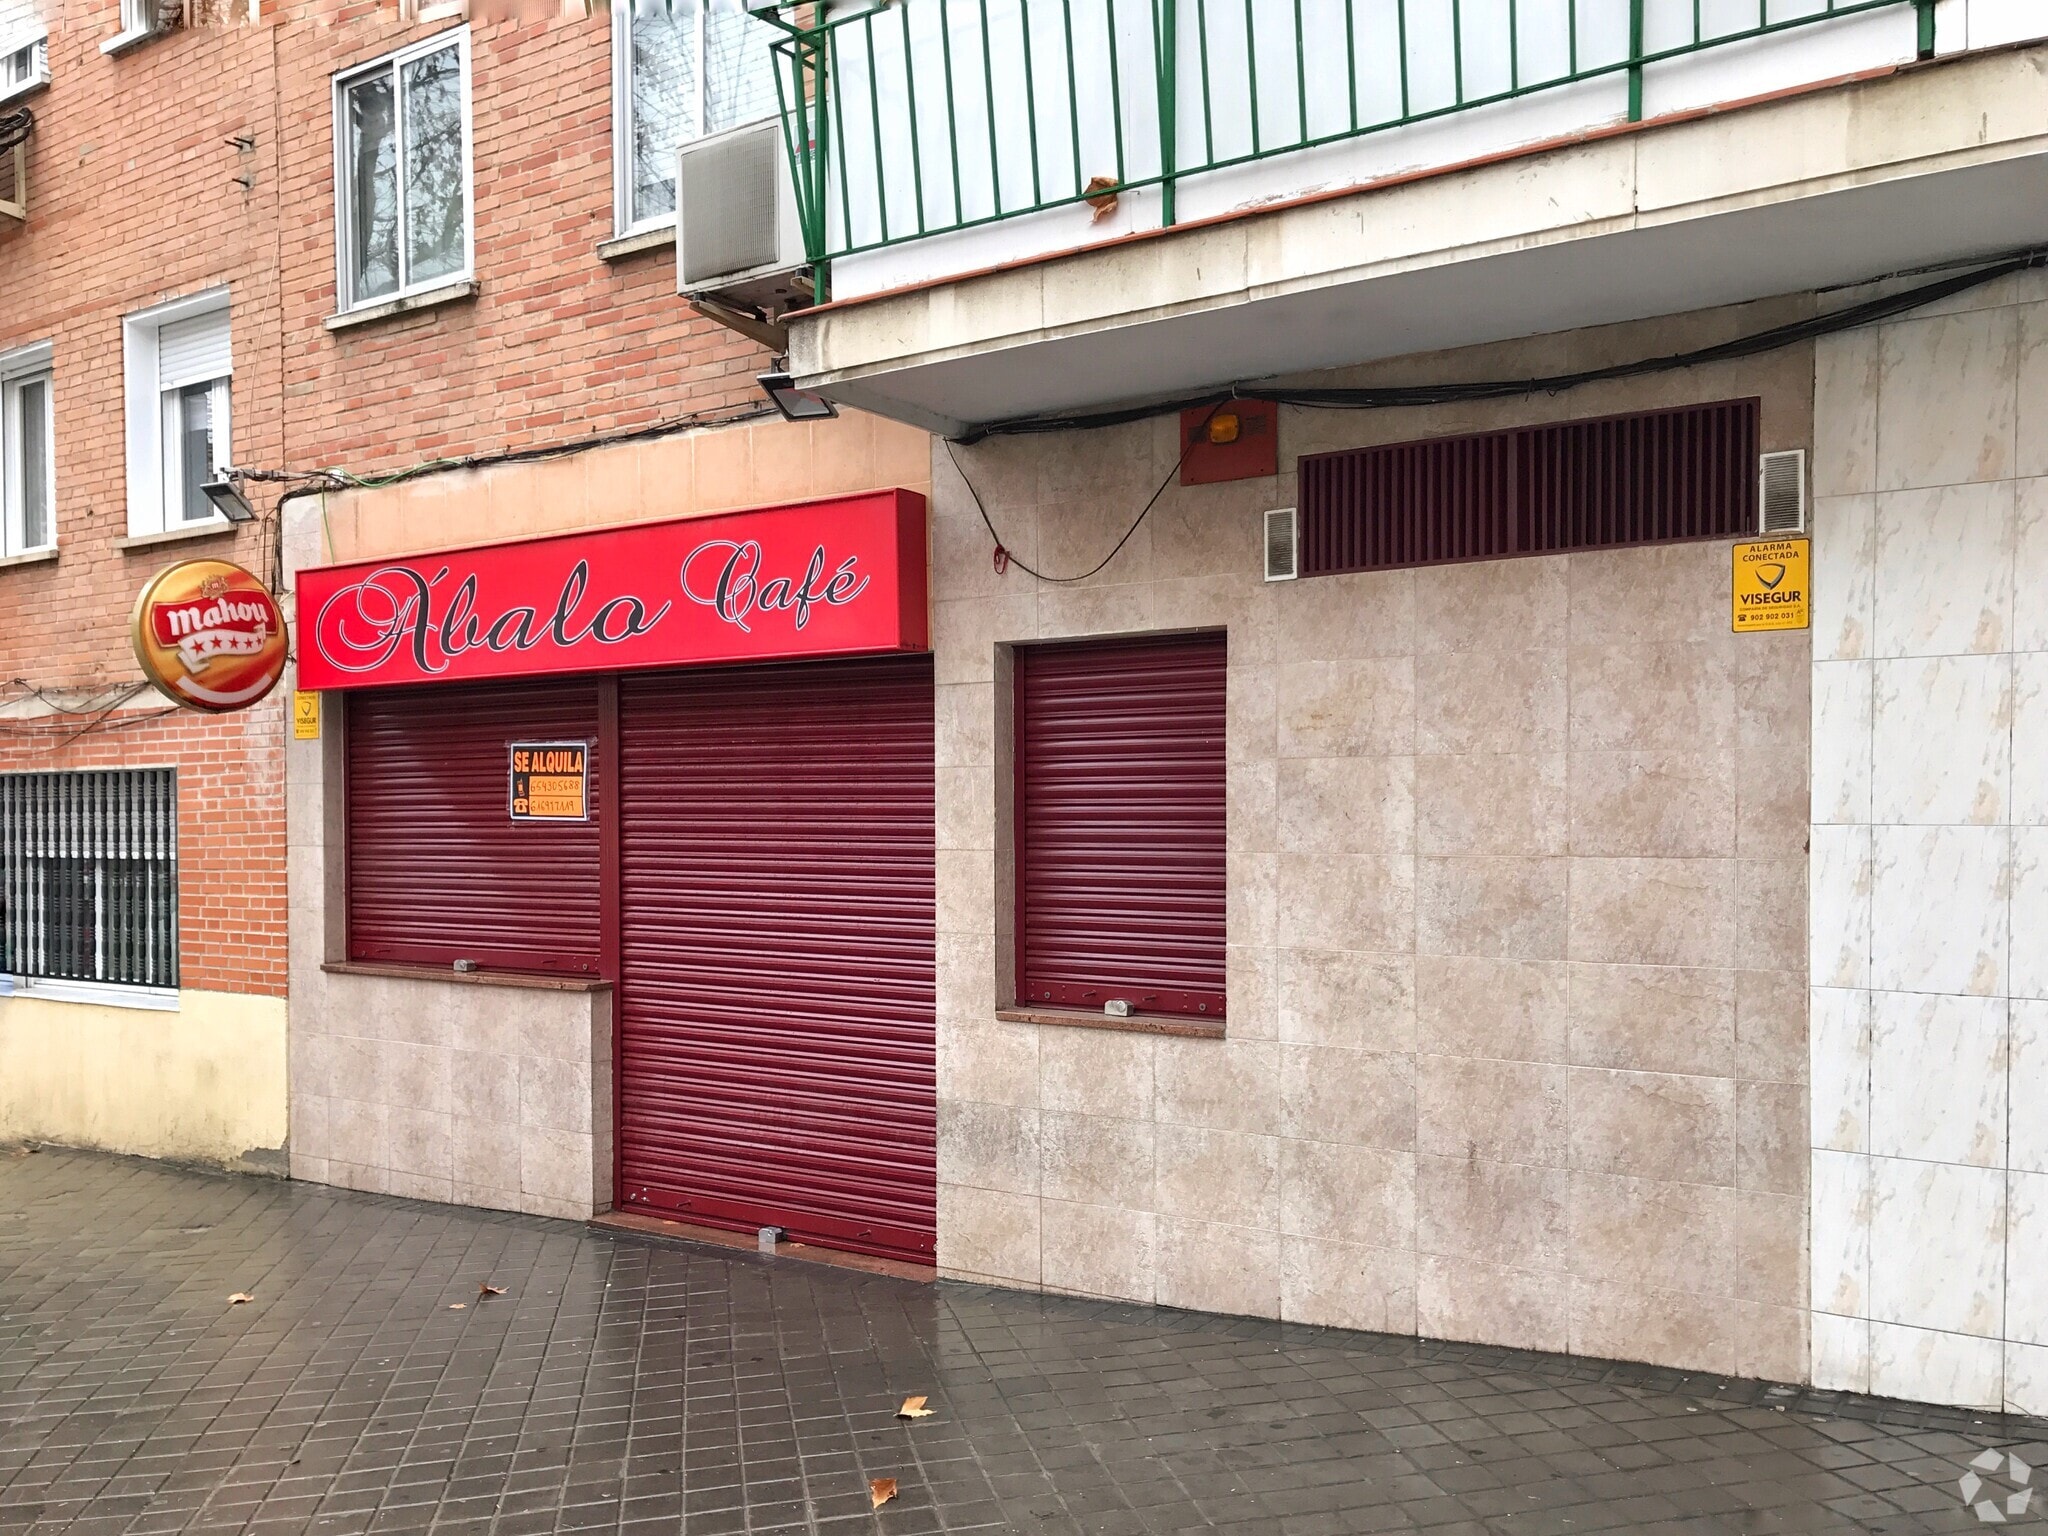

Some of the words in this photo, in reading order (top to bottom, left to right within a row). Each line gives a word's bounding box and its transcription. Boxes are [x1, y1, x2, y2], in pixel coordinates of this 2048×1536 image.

[1750, 542, 1792, 553] ALARMA
[1742, 551, 1799, 562] CONECTADA
[1740, 590, 1801, 605] VISEGUR
[315, 559, 671, 673] Ábalo
[680, 539, 869, 633] Café
[513, 751, 529, 773] SE
[531, 751, 583, 773] ALQUILA
